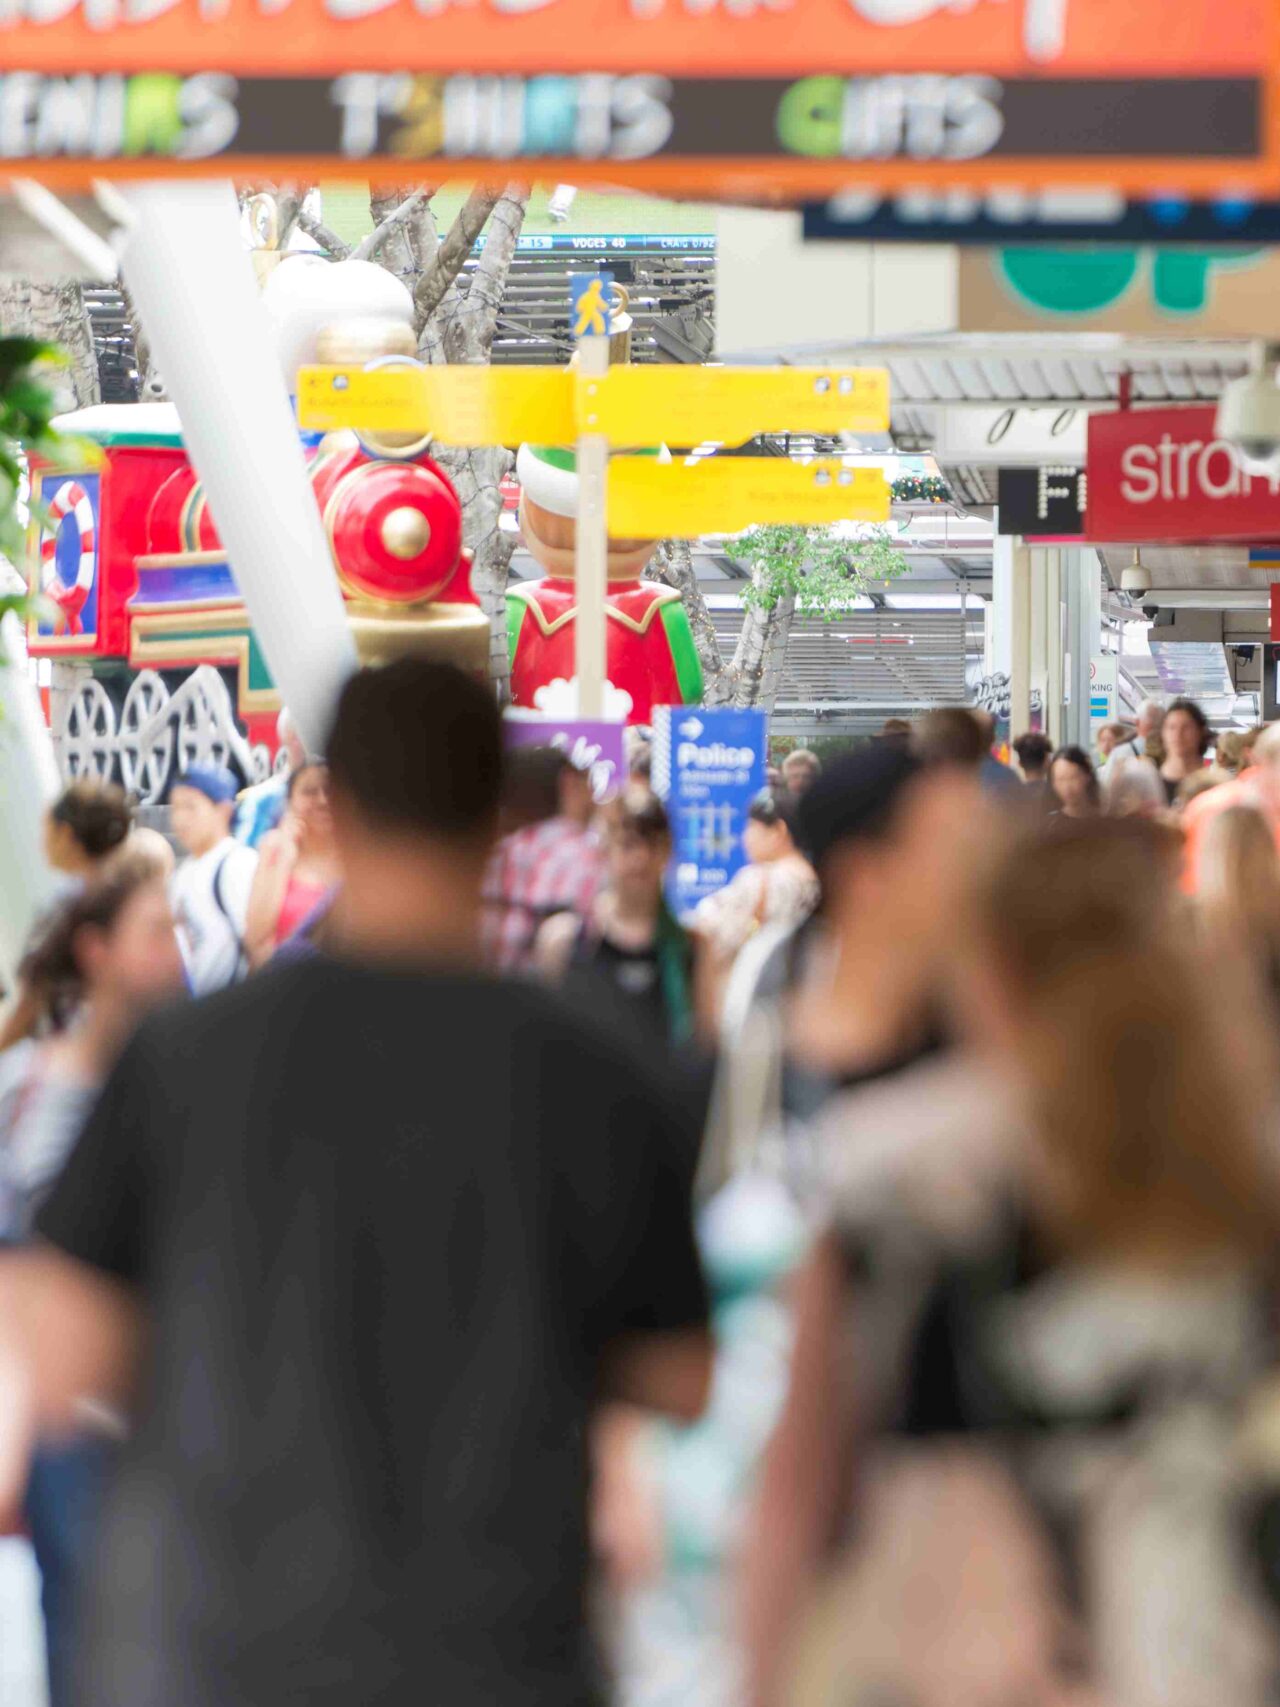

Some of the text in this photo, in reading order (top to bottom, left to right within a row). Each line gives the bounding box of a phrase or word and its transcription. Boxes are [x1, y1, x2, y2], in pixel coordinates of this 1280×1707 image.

[572, 238, 607, 248] VOGES
[611, 238, 627, 248] 40
[1089, 684, 1113, 692] KING
[677, 742, 755, 770] Police
